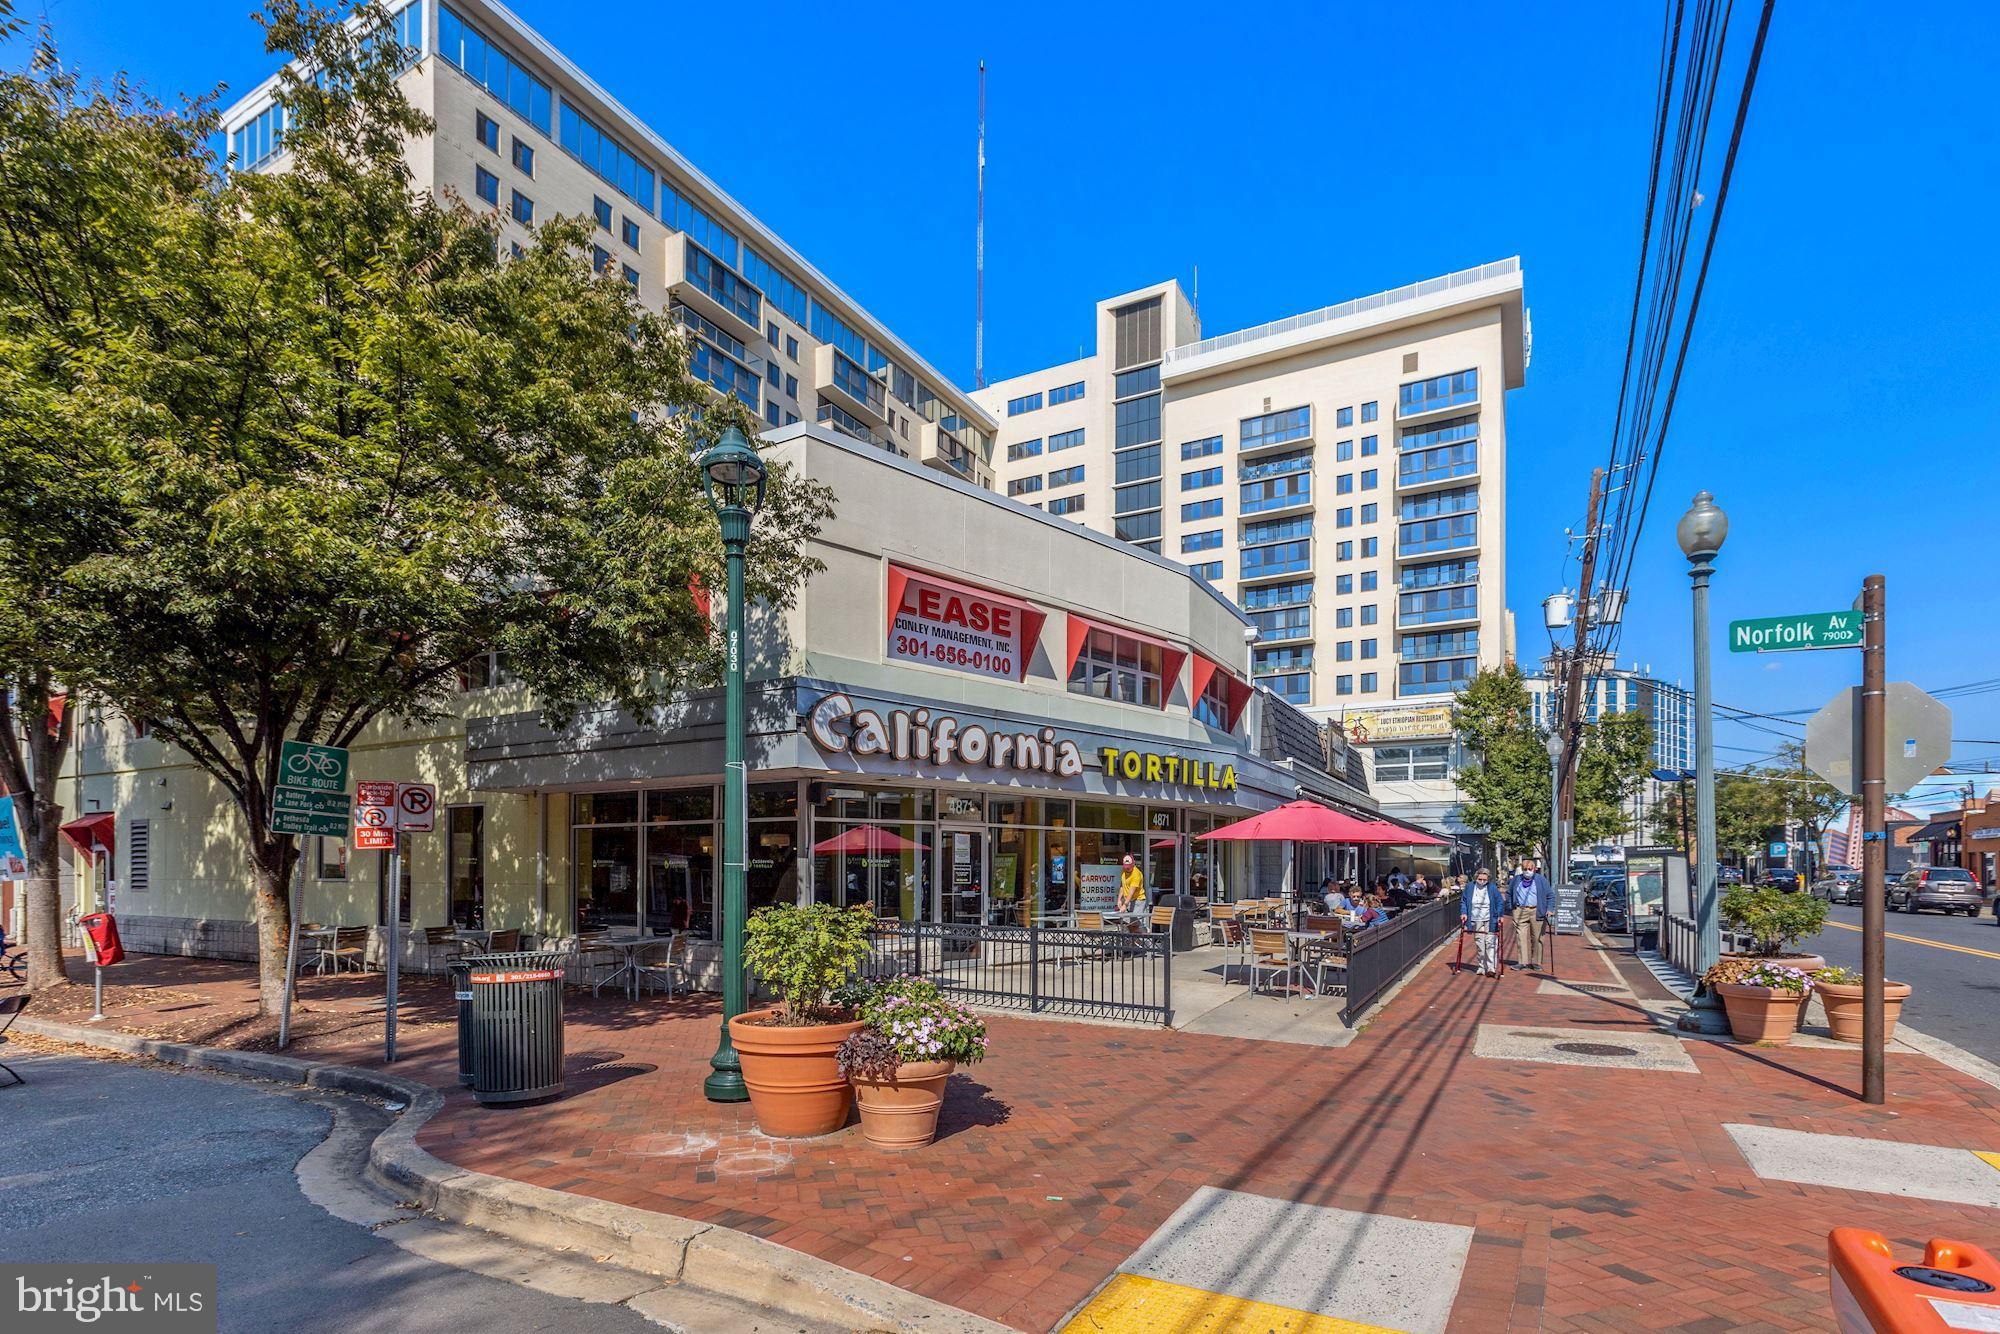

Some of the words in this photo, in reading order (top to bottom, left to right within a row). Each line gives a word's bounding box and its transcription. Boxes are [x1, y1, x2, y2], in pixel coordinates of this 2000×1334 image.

[898, 589, 1011, 638] LEASE
[896, 618, 929, 635] CONLEY
[932, 627, 994, 650] MANAGEMENT,
[996, 641, 1012, 653] INC.
[1737, 622, 1814, 646] Norfolk
[1829, 615, 1847, 629] Av
[1823, 631, 1847, 640] 7900
[897, 636, 1011, 674] 301-656-0100
[1380, 717, 1392, 725] LUCY
[1392, 715, 1415, 724] ETHIOPIAN
[1416, 713, 1444, 722] RESTAURANT
[807, 692, 1083, 777] California
[1099, 748, 1236, 790] TORTILLA
[287, 775, 308, 786] BIKE
[312, 777, 338, 789] ROUTE
[285, 791, 306, 800] Battery
[284, 799, 298, 807] Lane
[283, 815, 309, 823] Bethesda
[1152, 812, 1169, 826] 4871
[282, 822, 301, 831] Trolley
[1773, 845, 1784, 853] P
